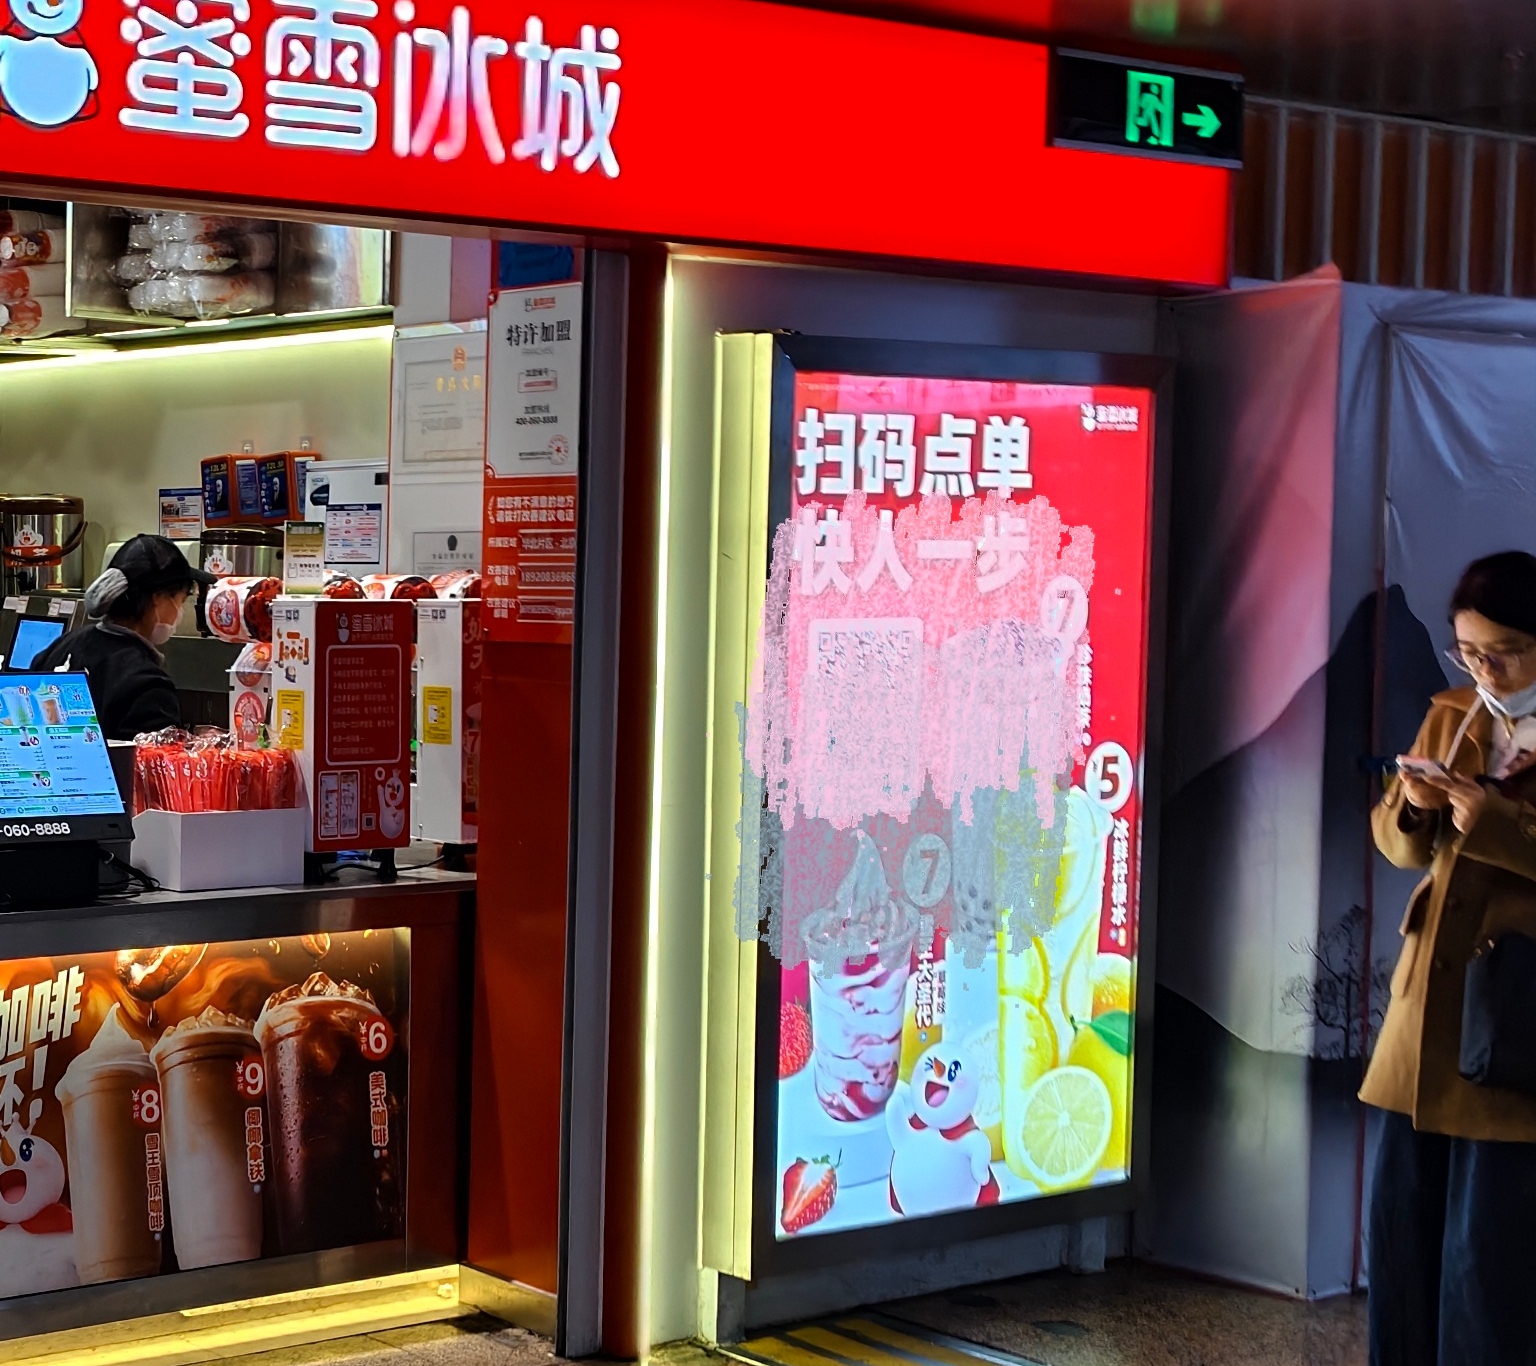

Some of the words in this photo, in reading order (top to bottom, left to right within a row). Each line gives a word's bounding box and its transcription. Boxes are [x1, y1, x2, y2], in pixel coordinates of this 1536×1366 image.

[506, 320, 571, 346] 特许加盟
[795, 407, 1032, 498] 扫码点单
[793, 509, 1031, 596] 快人一步
[369, 1071, 389, 1147] 美式咖啡
[145, 1133, 164, 1232] 雪王雪顶咖啡
